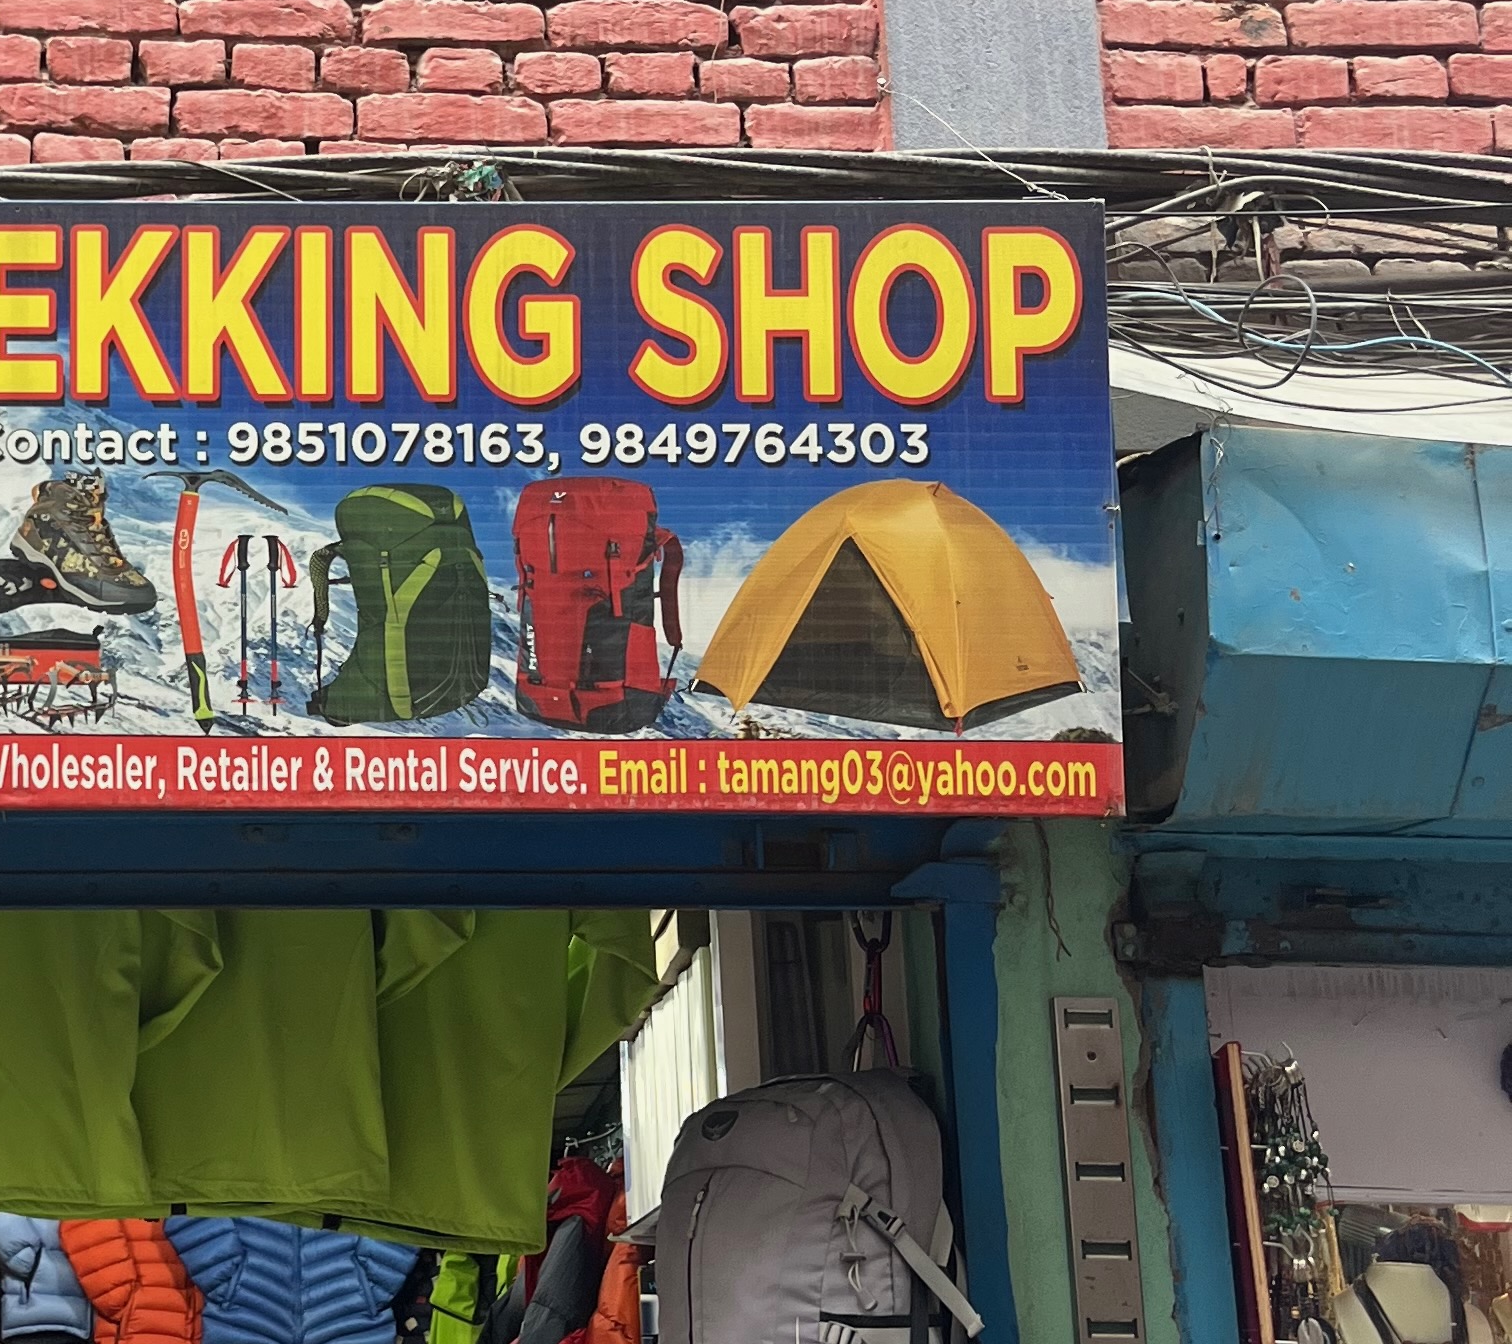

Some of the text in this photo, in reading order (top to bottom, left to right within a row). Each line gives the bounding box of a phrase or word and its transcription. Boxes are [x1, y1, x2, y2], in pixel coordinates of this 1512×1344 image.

[629, 222, 1084, 405] SHOP
[196, 431, 208, 462] :
[227, 422, 560, 471] 9851078163,
[579, 423, 929, 464] 9849764303
[178, 745, 302, 792] Retailer
[313, 746, 333, 792] &
[345, 746, 447, 792] Rental
[459, 747, 588, 795] Service.
[599, 750, 687, 795] Email
[718, 751, 1097, 806] tamang03@yahoo.com
